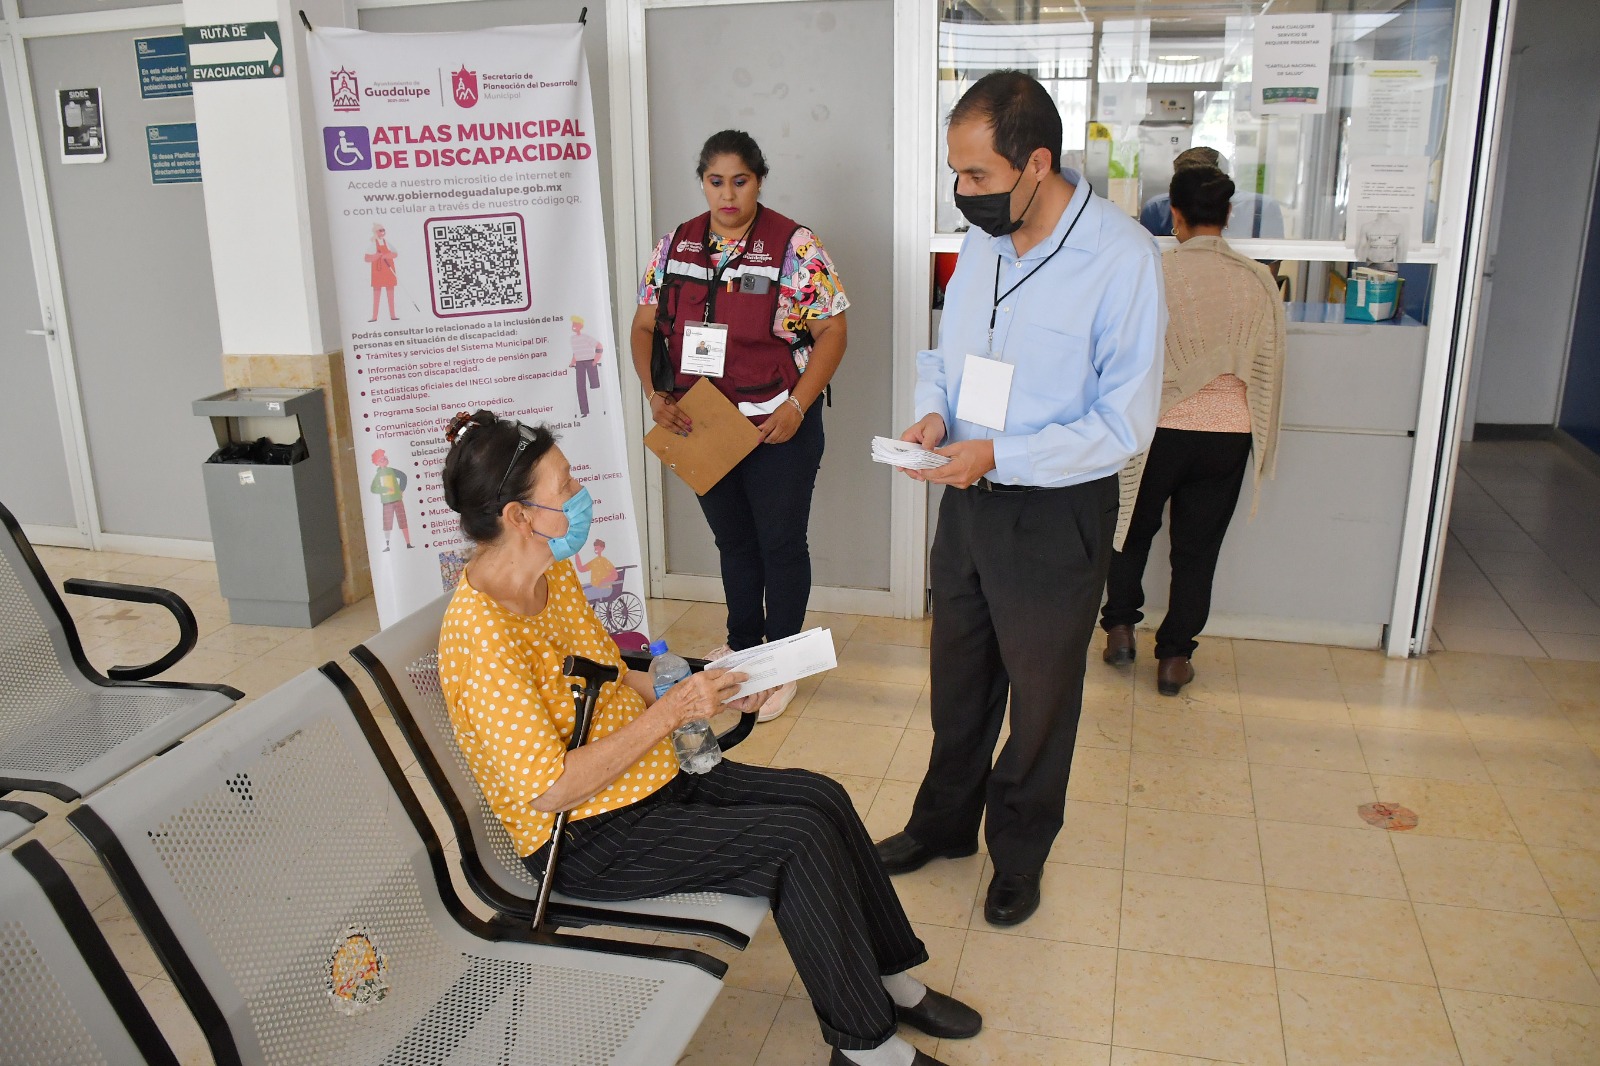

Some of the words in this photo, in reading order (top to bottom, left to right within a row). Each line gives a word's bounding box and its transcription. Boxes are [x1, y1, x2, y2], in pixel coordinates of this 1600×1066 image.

[200, 28, 229, 40] RUTA
[232, 26, 247, 37] DE
[193, 65, 264, 79] EVACUACION
[364, 86, 431, 98] Guadalupe
[483, 82, 526, 90] Planeación
[540, 80, 578, 88] Desarrollo
[484, 92, 521, 100] Municipal
[372, 124, 452, 146] ATLAS
[457, 118, 586, 142] MUNICIPAL
[375, 151, 409, 170] DE
[415, 143, 592, 168] DISCAPACIDAD
[348, 180, 388, 190] Accede
[400, 178, 441, 187] nuestro
[444, 174, 497, 185] micrositio
[500, 174, 513, 182] de
[516, 171, 557, 181] internet
[363, 184, 562, 202] www.gobiernodeguadalupe.gob.mx
[353, 208, 373, 216] con
[376, 206, 387, 215] tu
[390, 204, 427, 214] celular
[438, 202, 470, 211] través
[472, 201, 486, 209] de
[488, 199, 529, 208] nuestro
[531, 196, 565, 206] código
[566, 195, 582, 204] QR.
[352, 331, 382, 340] Podrás
[383, 328, 424, 337] consultar
[425, 326, 434, 334] lo
[435, 322, 486, 332] relacionado
[494, 320, 502, 328] la
[503, 317, 541, 327] inclusión
[353, 342, 393, 352] personas
[406, 336, 446, 345] situación
[459, 329, 518, 340] discapacidad:
[366, 351, 402, 360] Trámites
[409, 347, 445, 356] servicios
[446, 345, 460, 353] del
[461, 342, 494, 352] Sistema
[495, 338, 534, 348] Municipal
[535, 336, 549, 345] DIF.
[368, 363, 418, 375] Información
[419, 362, 442, 370] sobre
[453, 358, 485, 367] registro
[486, 355, 497, 363] de
[498, 353, 529, 363] pensión
[530, 351, 547, 360] para
[369, 373, 406, 384] personas
[424, 365, 480, 376] discapacidad.
[370, 386, 419, 396] Estadísticas
[420, 382, 454, 391] oficiales
[455, 380, 468, 388] del
[469, 377, 493, 386] INEGI
[494, 375, 516, 384] sobre
[517, 369, 568, 381] discapacidad
[384, 392, 430, 402] Guadalupe.
[374, 407, 414, 418] Programa
[415, 404, 439, 413] Social
[441, 402, 466, 410] Banco
[468, 397, 515, 408] Ortopédico.
[517, 406, 554, 415] cualquier
[375, 419, 434, 432] Comunicación
[435, 417, 451, 425] dire
[548, 421, 572, 430] indica
[376, 428, 426, 439] información
[410, 437, 446, 447] Consulta
[424, 471, 443, 479] Tien
[425, 483, 444, 491] Ram
[427, 495, 445, 504] Cent
[430, 519, 460, 529] Bibliote
[442, 525, 461, 534] siste
[433, 538, 463, 548] Centros
